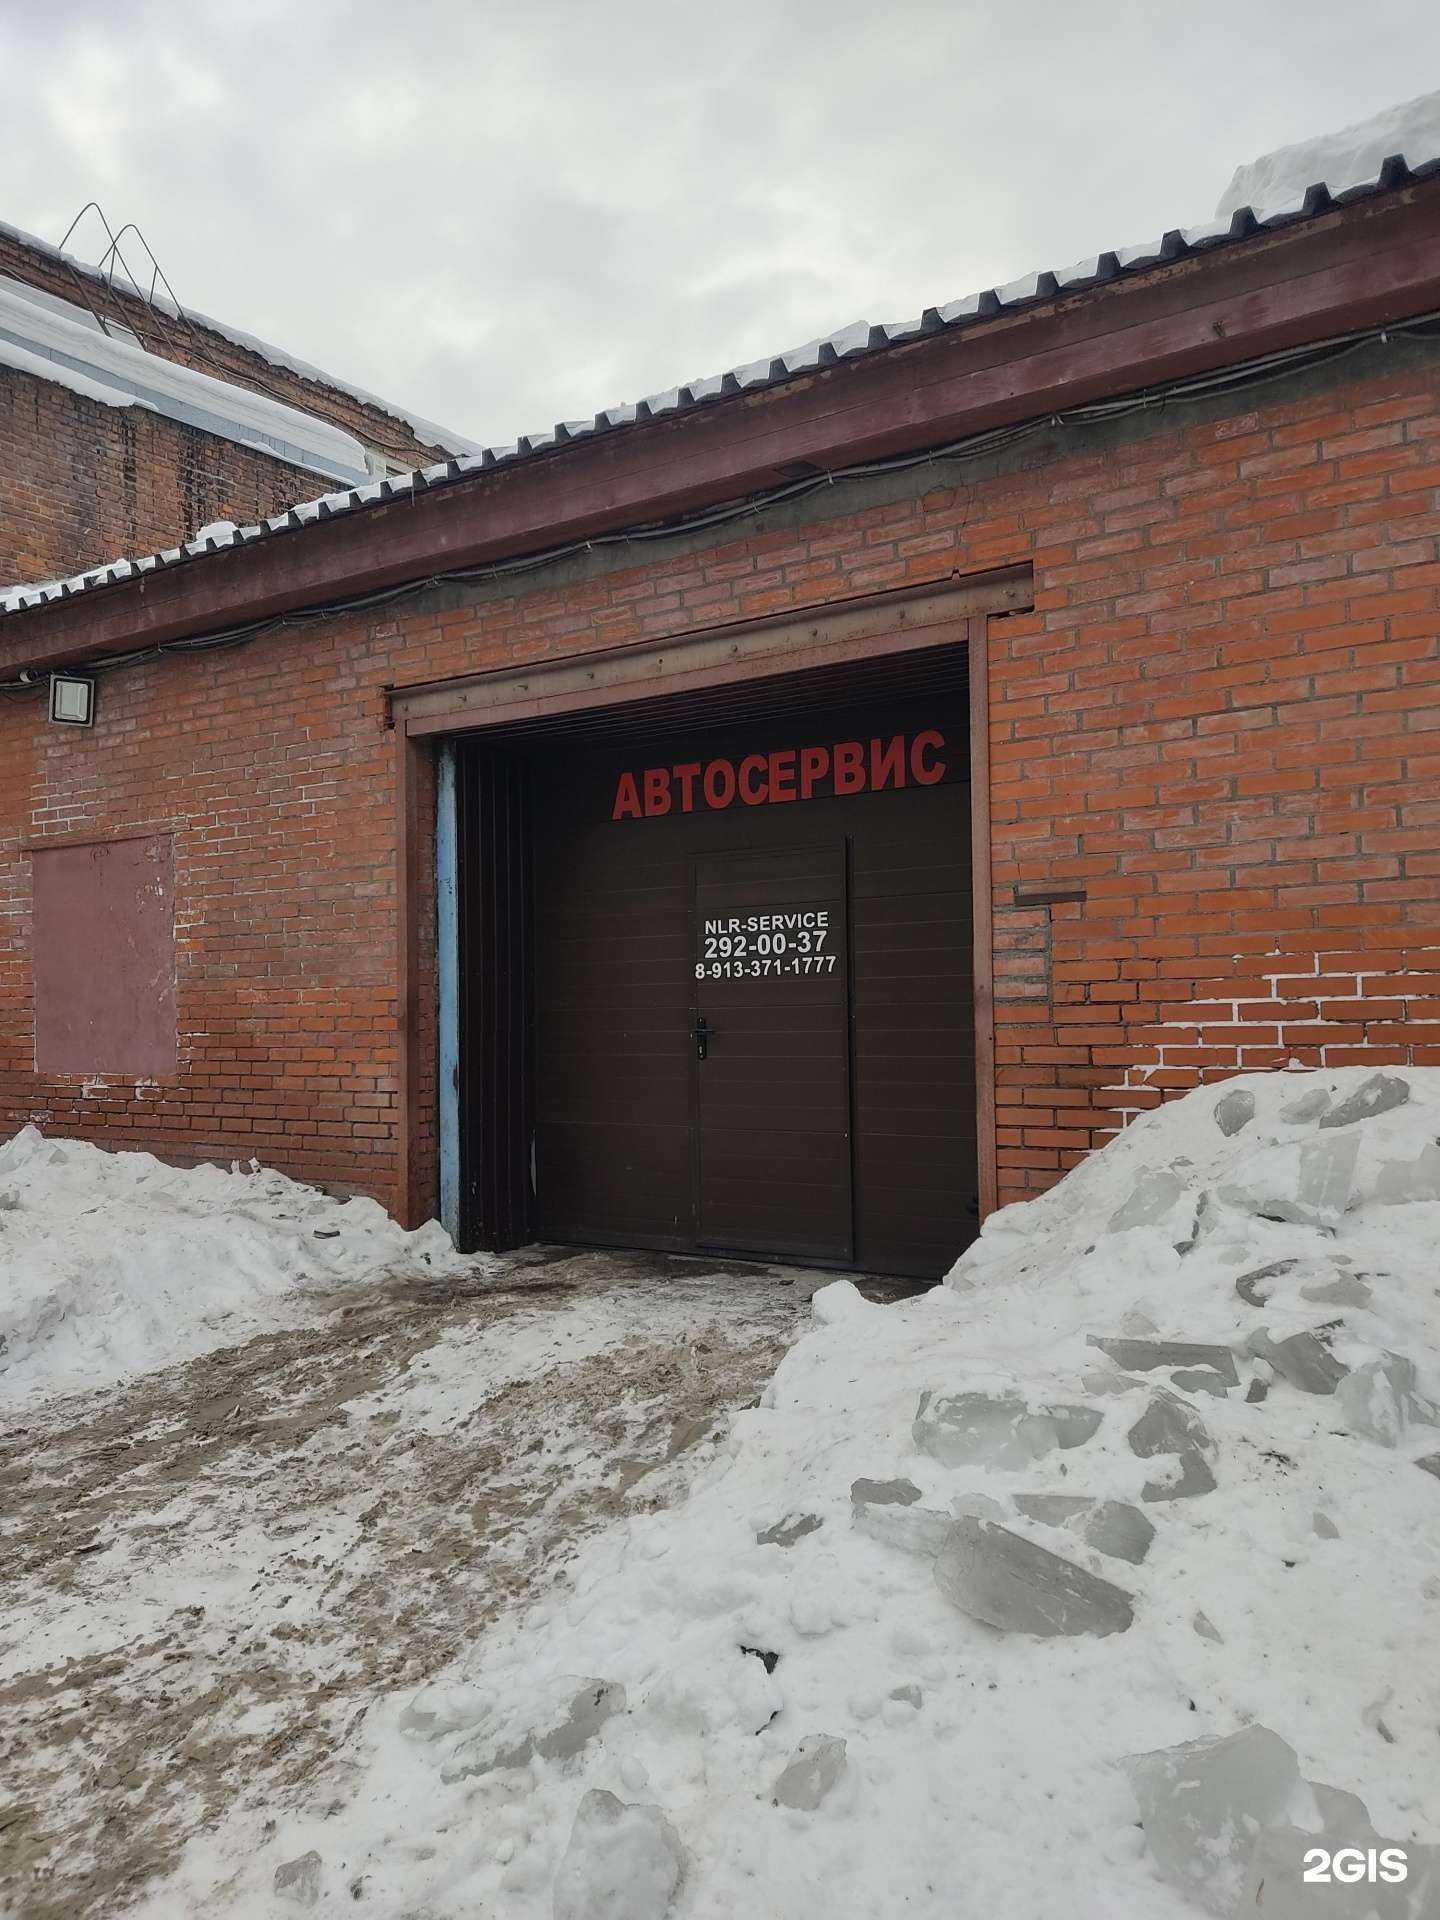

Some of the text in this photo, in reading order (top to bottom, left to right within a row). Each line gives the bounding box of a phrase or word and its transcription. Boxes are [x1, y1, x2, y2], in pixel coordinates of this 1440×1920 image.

[612, 729, 946, 820] АВТОСЕРВИС
[704, 911, 829, 935] NLR-SERVICE
[704, 930, 828, 959] 292-00-37
[694, 955, 837, 979] 8-913-371-1777
